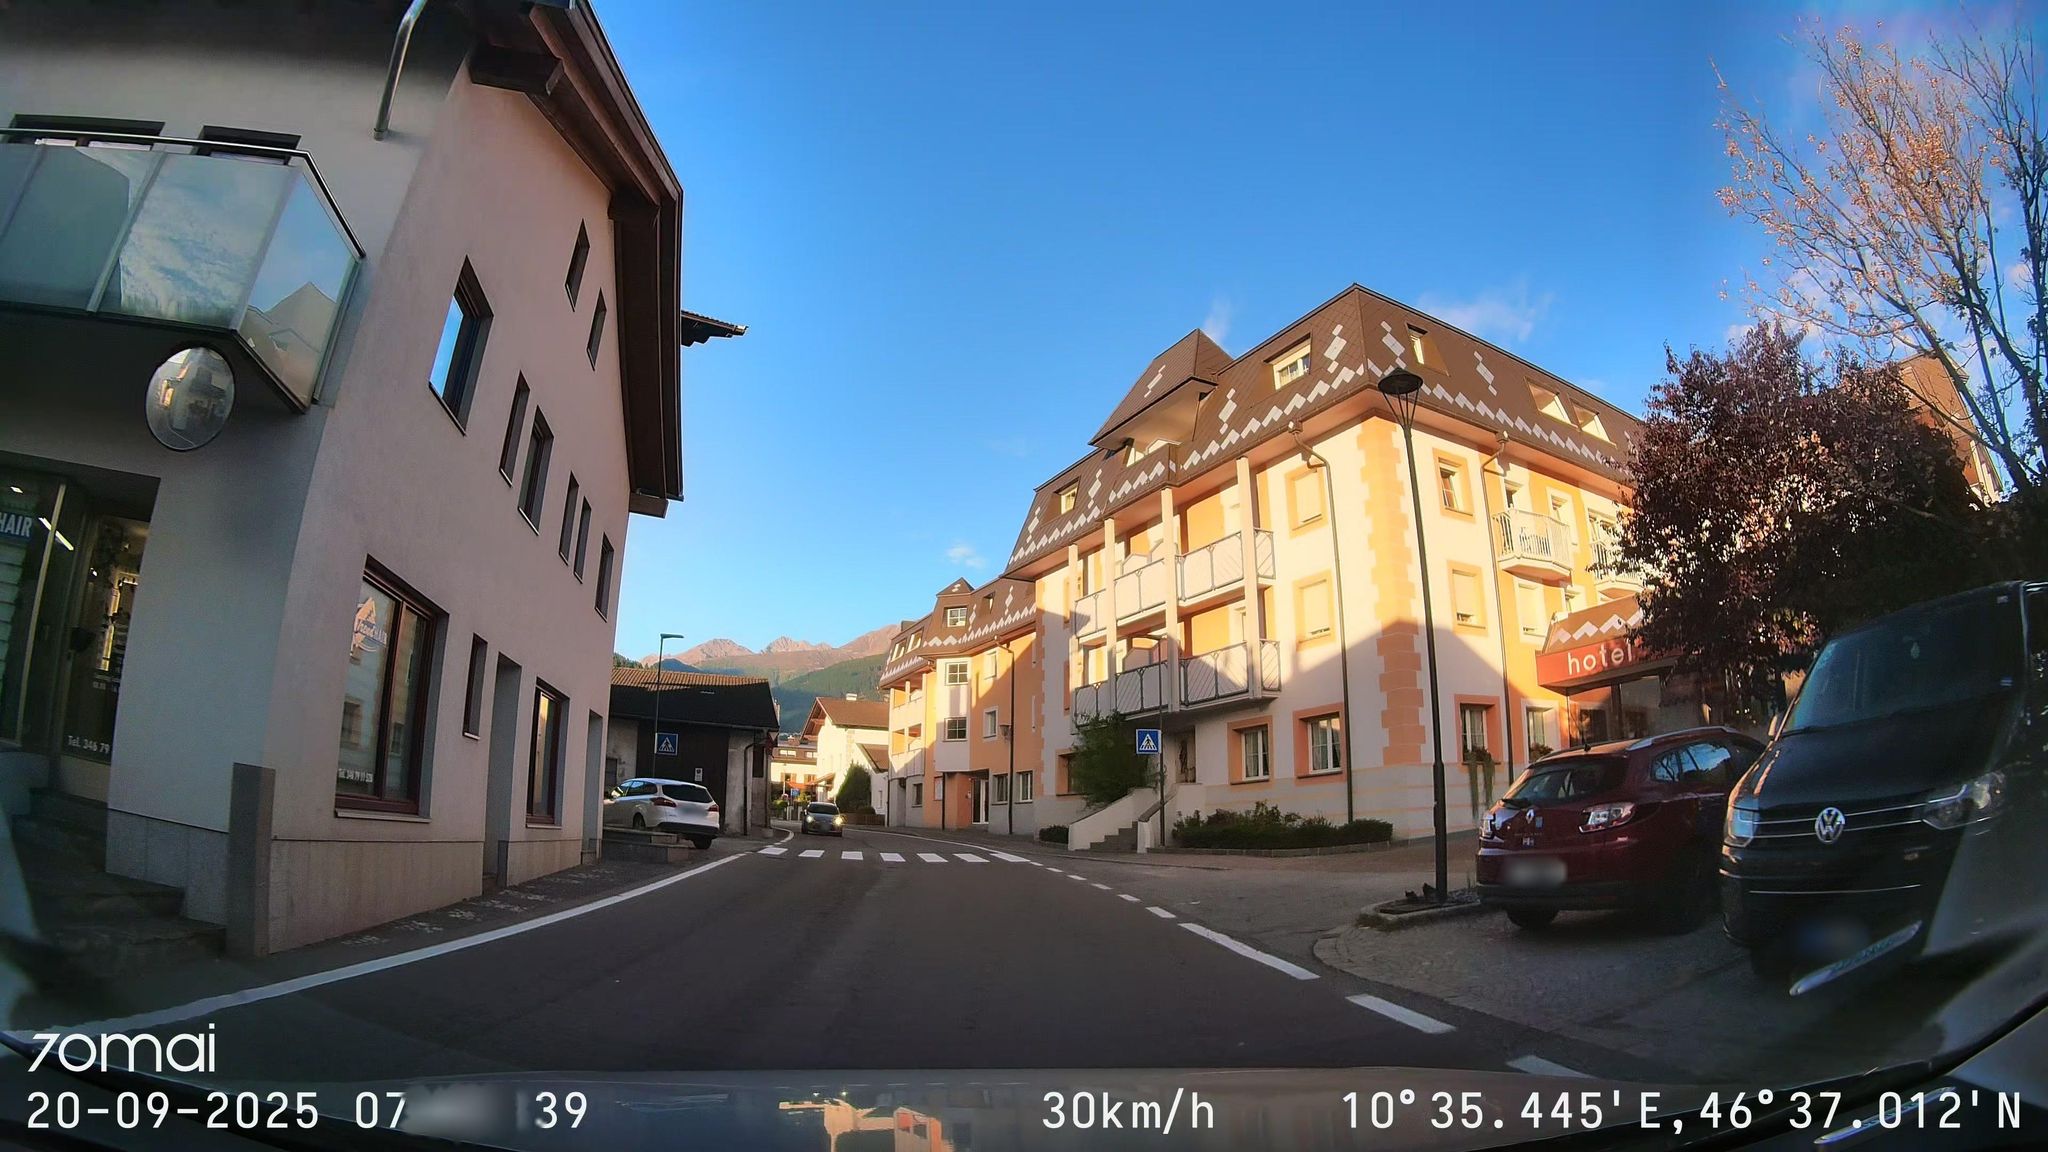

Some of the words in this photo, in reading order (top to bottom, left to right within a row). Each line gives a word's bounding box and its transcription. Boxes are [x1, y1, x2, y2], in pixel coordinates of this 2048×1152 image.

[0, 512, 32, 538] HAIR
[1567, 640, 1632, 676] hotel
[82, 739, 98, 752] 346
[99, 742, 111, 754] 79
